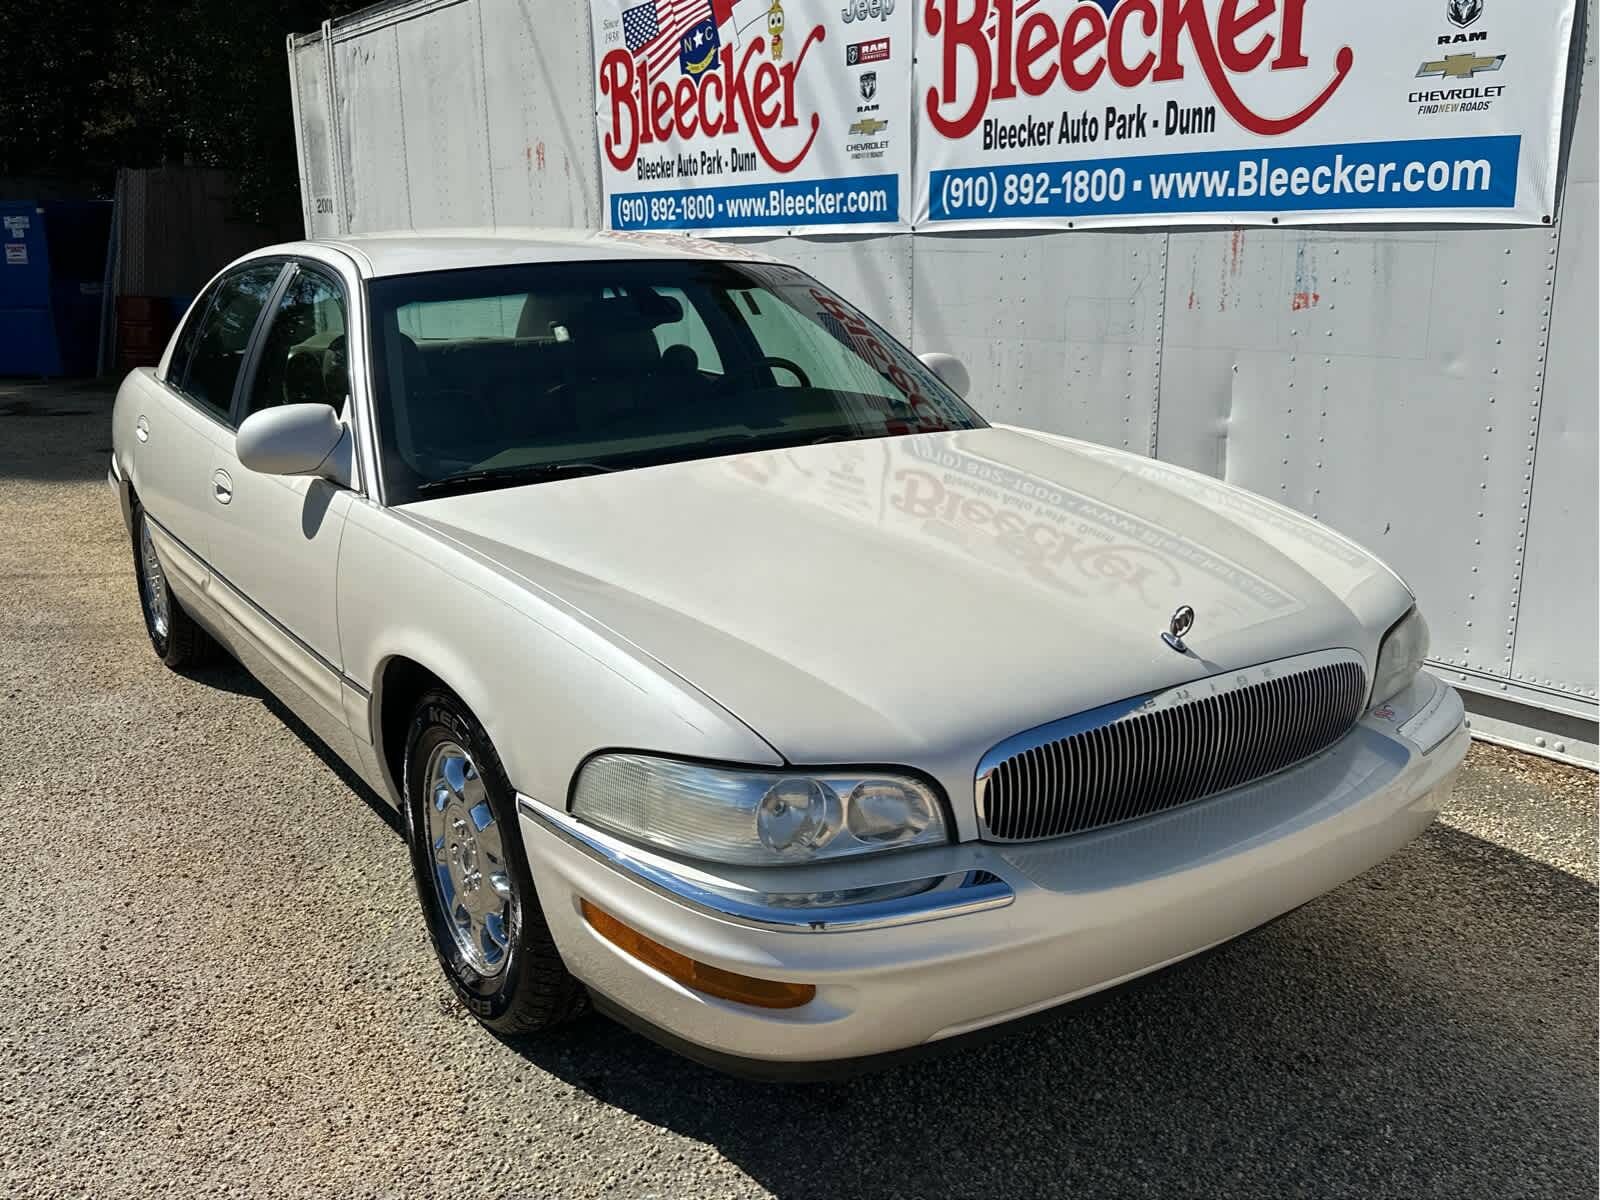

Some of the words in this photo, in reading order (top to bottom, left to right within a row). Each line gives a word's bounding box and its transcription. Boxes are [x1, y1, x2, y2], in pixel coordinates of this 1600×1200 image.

[841, 0, 895, 24] Jeep
[861, 42, 888, 54] RAM
[1437, 31, 1487, 45] RAM
[925, 0, 1354, 138] Bleecker
[600, 25, 826, 172] Bleecker
[1408, 85, 1506, 103] CHEVROLET
[856, 104, 880, 113] RAM
[1418, 104, 1439, 115] FIND
[1439, 102, 1459, 113] NEW
[1459, 100, 1490, 112] ROADS
[983, 114, 1054, 150] Bleecker
[1058, 110, 1099, 144] Auto
[1104, 103, 1147, 141] Park
[1165, 100, 1216, 136] Dunn
[846, 140, 889, 152] CHEVROLET
[637, 156, 674, 180] Bleecker
[677, 153, 698, 177] Auto
[700, 149, 723, 175] Park
[731, 148, 757, 172] Dunn
[943, 171, 998, 214] (910)
[1004, 168, 1126, 205] 892-1800
[1150, 154, 1491, 199] www.Bleecker.com
[618, 196, 648, 227] (910)
[651, 194, 715, 220] 892-1800
[726, 187, 887, 218] www.Bleecker.com
